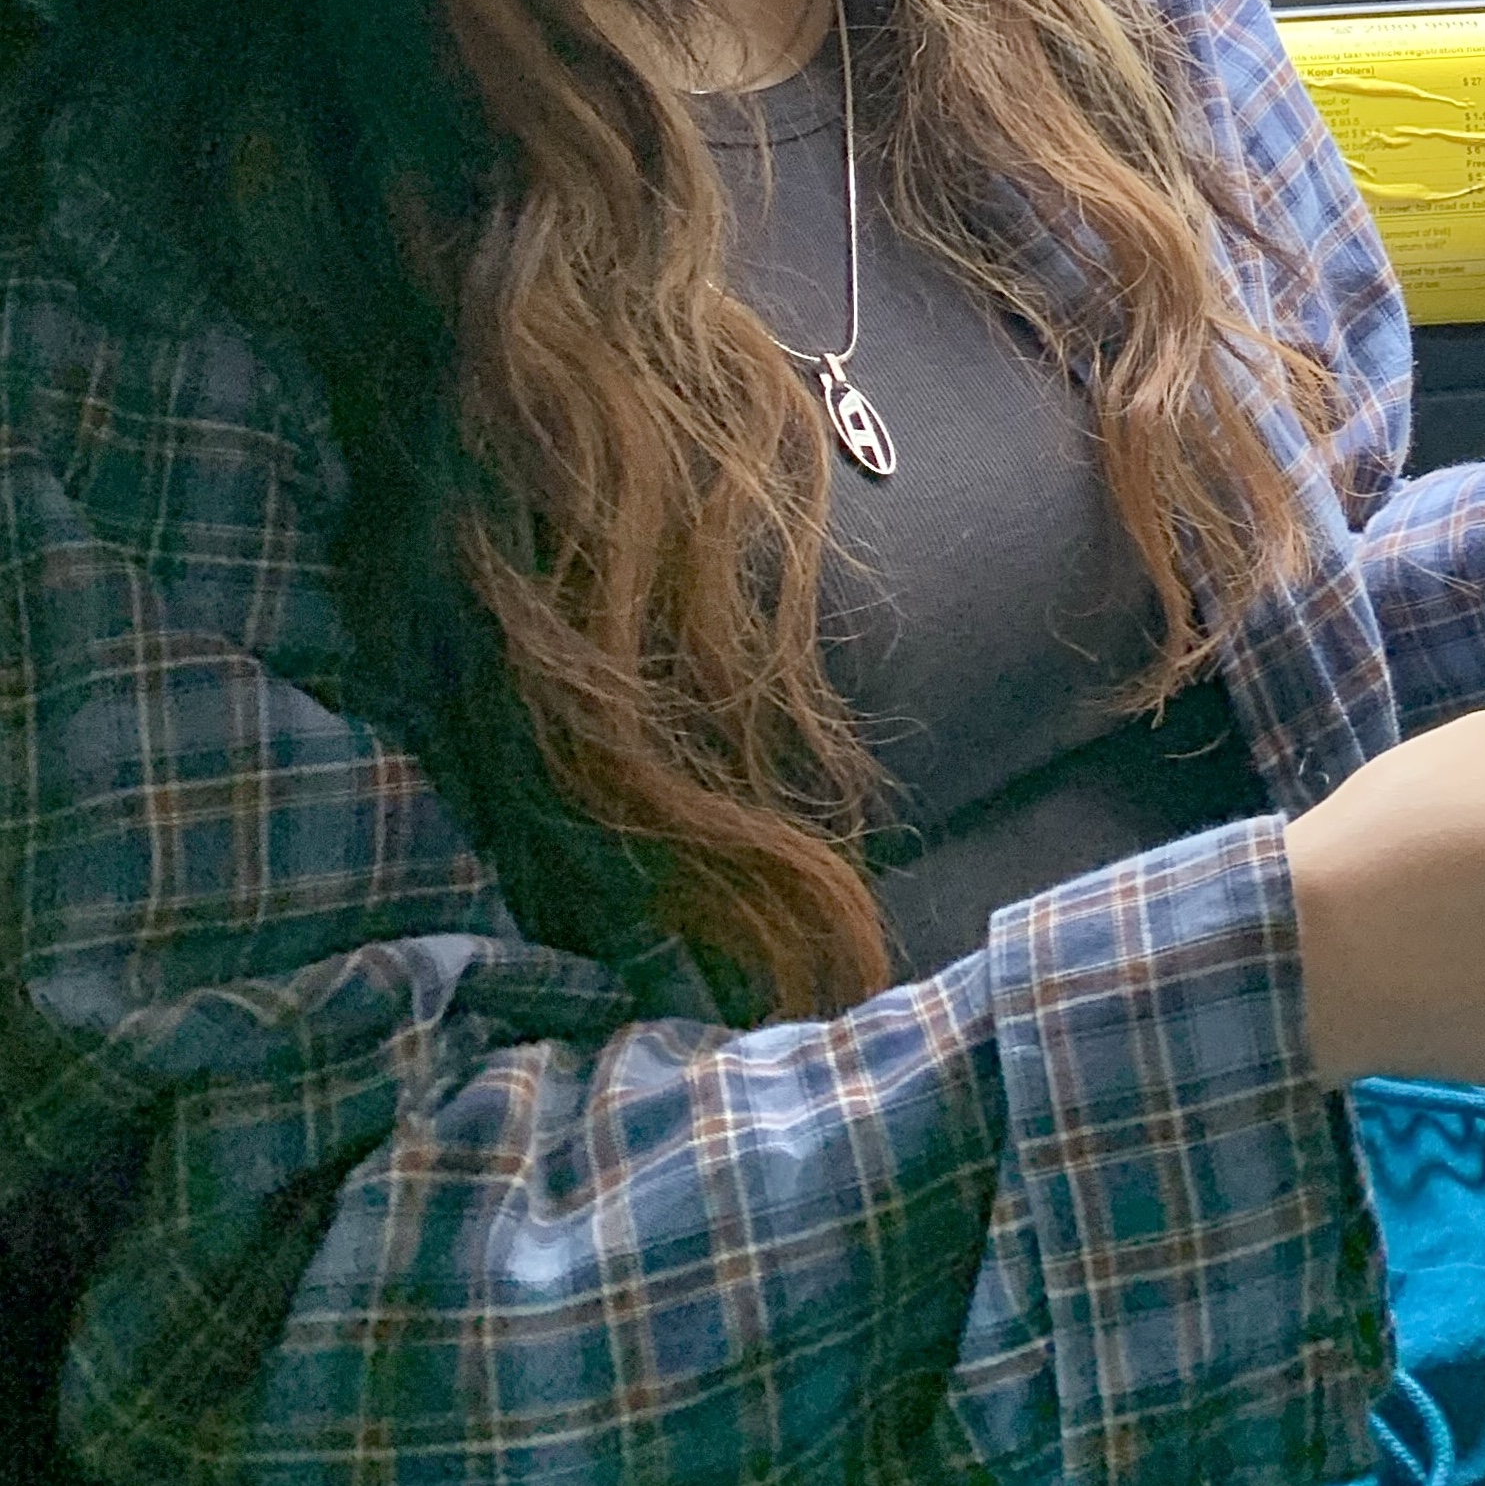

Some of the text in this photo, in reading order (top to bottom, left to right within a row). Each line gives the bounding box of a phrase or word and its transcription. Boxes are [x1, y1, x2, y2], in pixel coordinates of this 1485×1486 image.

[1343, 51, 1362, 59] taxi
[1365, 49, 1401, 57] vehicle
[1405, 45, 1463, 57] registration
[1307, 66, 1334, 78] Kong
